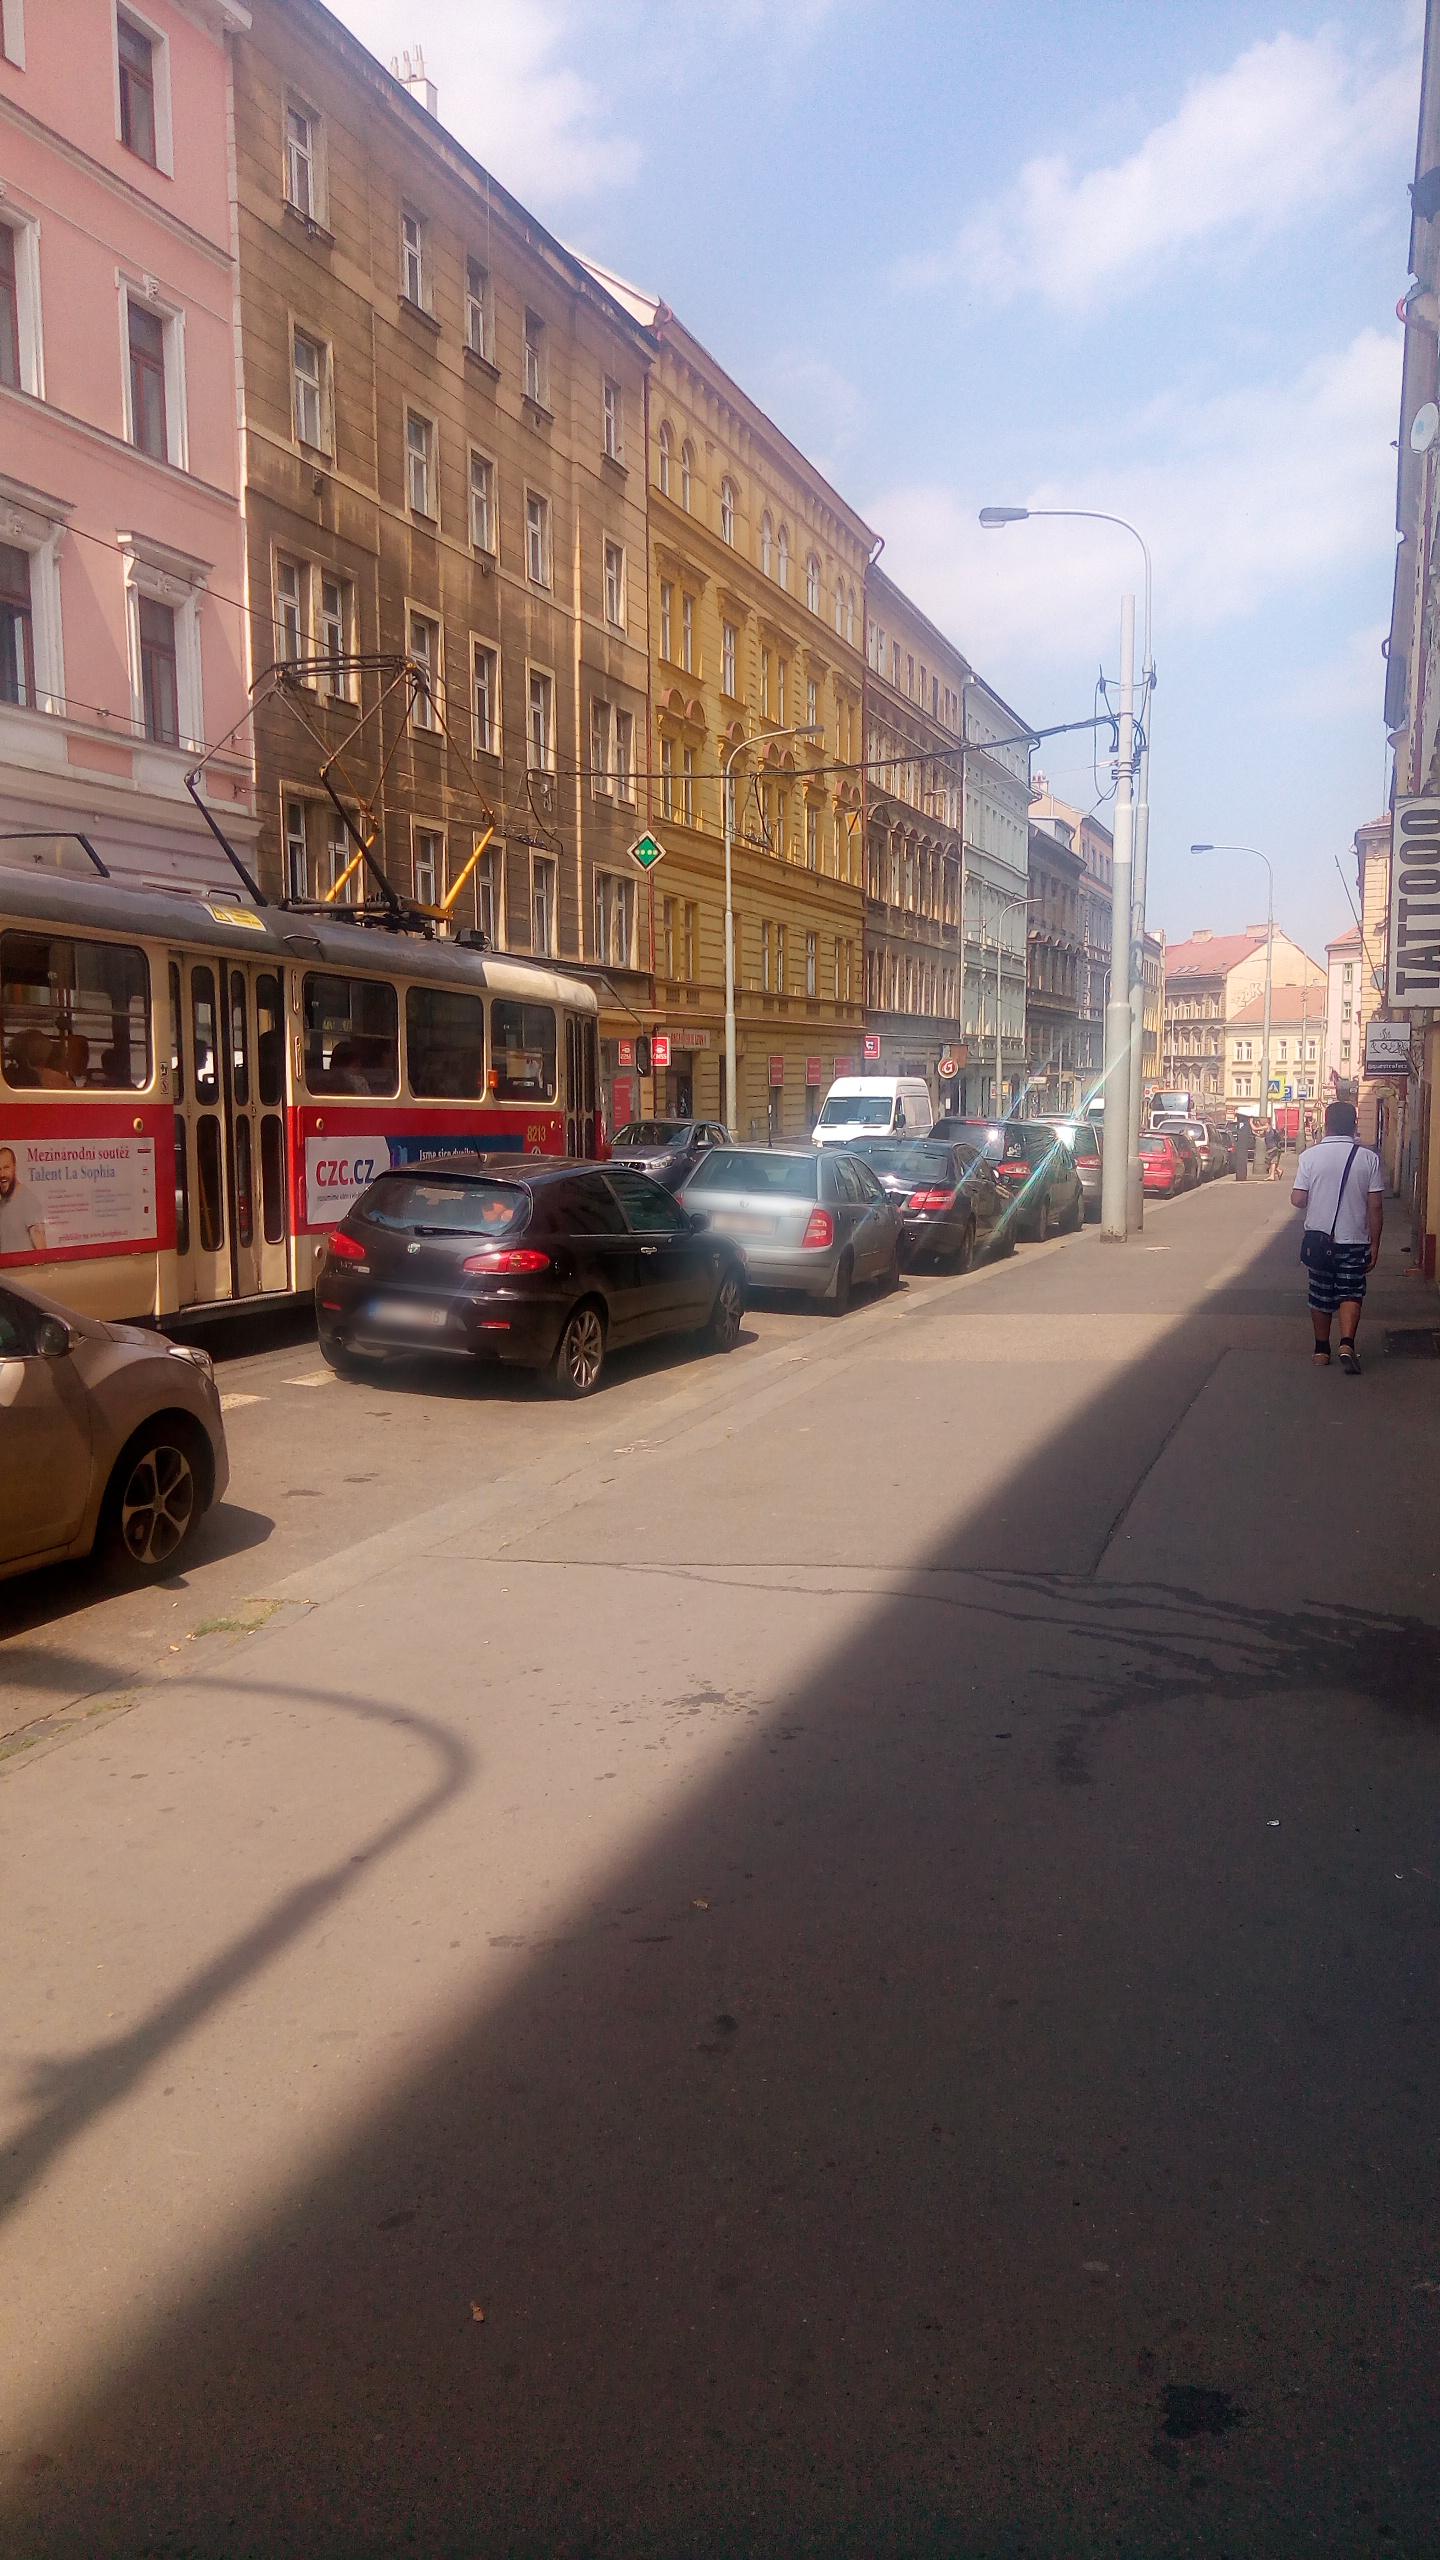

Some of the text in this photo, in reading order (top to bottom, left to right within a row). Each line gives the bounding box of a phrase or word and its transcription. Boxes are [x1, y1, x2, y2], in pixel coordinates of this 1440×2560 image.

[1396, 809, 1440, 996] TATTOO
[527, 1125, 546, 1142] 8213
[29, 1164, 116, 1182] Talent La Sophia
[316, 1159, 375, 1187] CZC.CZ
